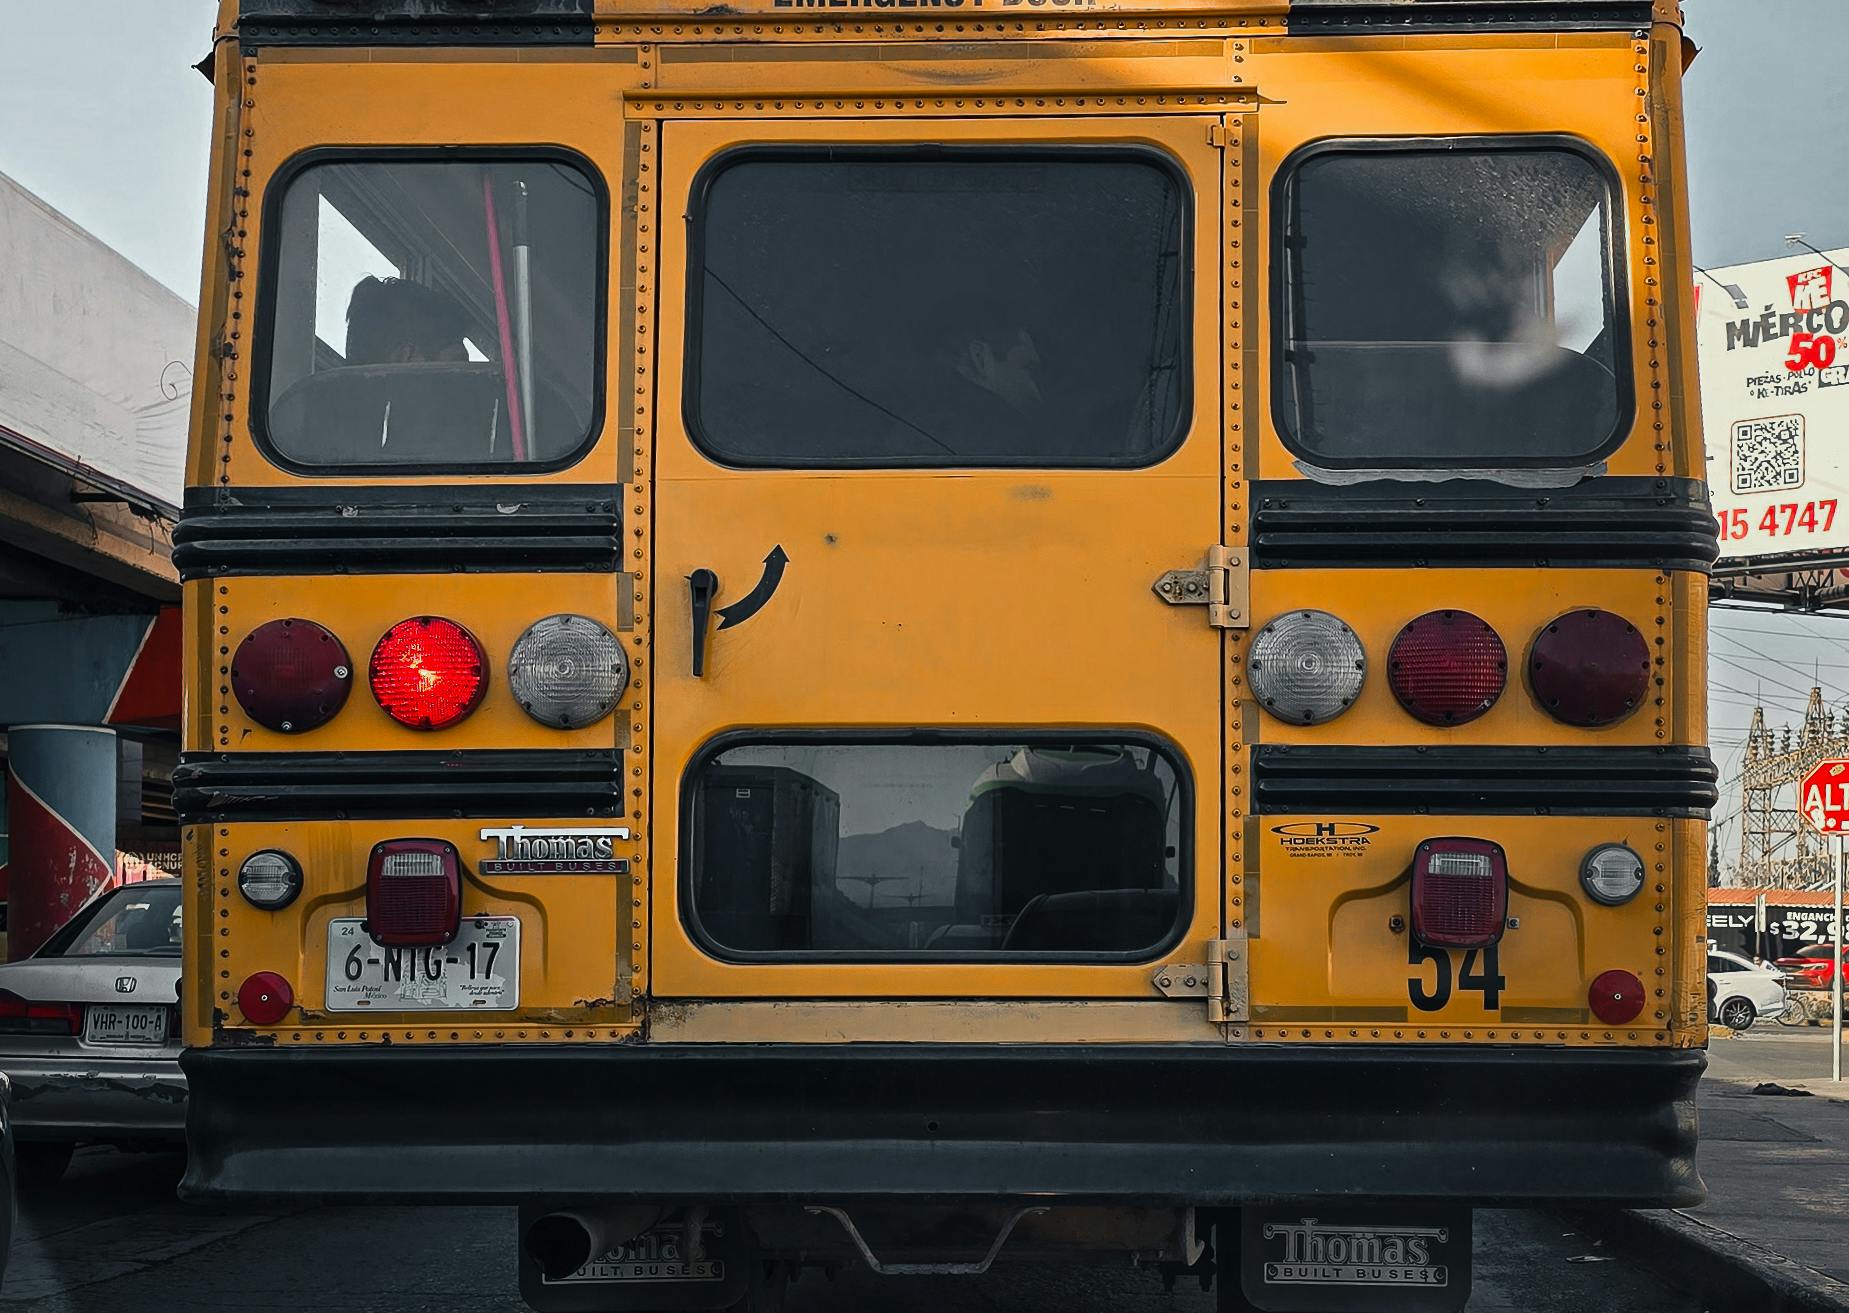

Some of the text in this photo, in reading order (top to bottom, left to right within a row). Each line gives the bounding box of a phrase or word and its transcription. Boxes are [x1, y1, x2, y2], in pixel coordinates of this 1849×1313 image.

[1746, 374, 1781, 387] PIEZAS
[1717, 499, 1838, 540] 15 4747
[481, 826, 629, 860] Thomas
[1280, 837, 1371, 845] HOEKSTRA
[495, 863, 616, 871] BUILT BUSES
[1786, 912, 1836, 922] ENGANCH
[342, 927, 354, 936] 24
[1408, 924, 1505, 1011] 54
[93, 1013, 161, 1031] VHR-100-A
[1264, 1218, 1448, 1266] Thomas
[577, 1265, 705, 1277] UILT BUSES
[1284, 1267, 1429, 1281] BUILT BUSES
